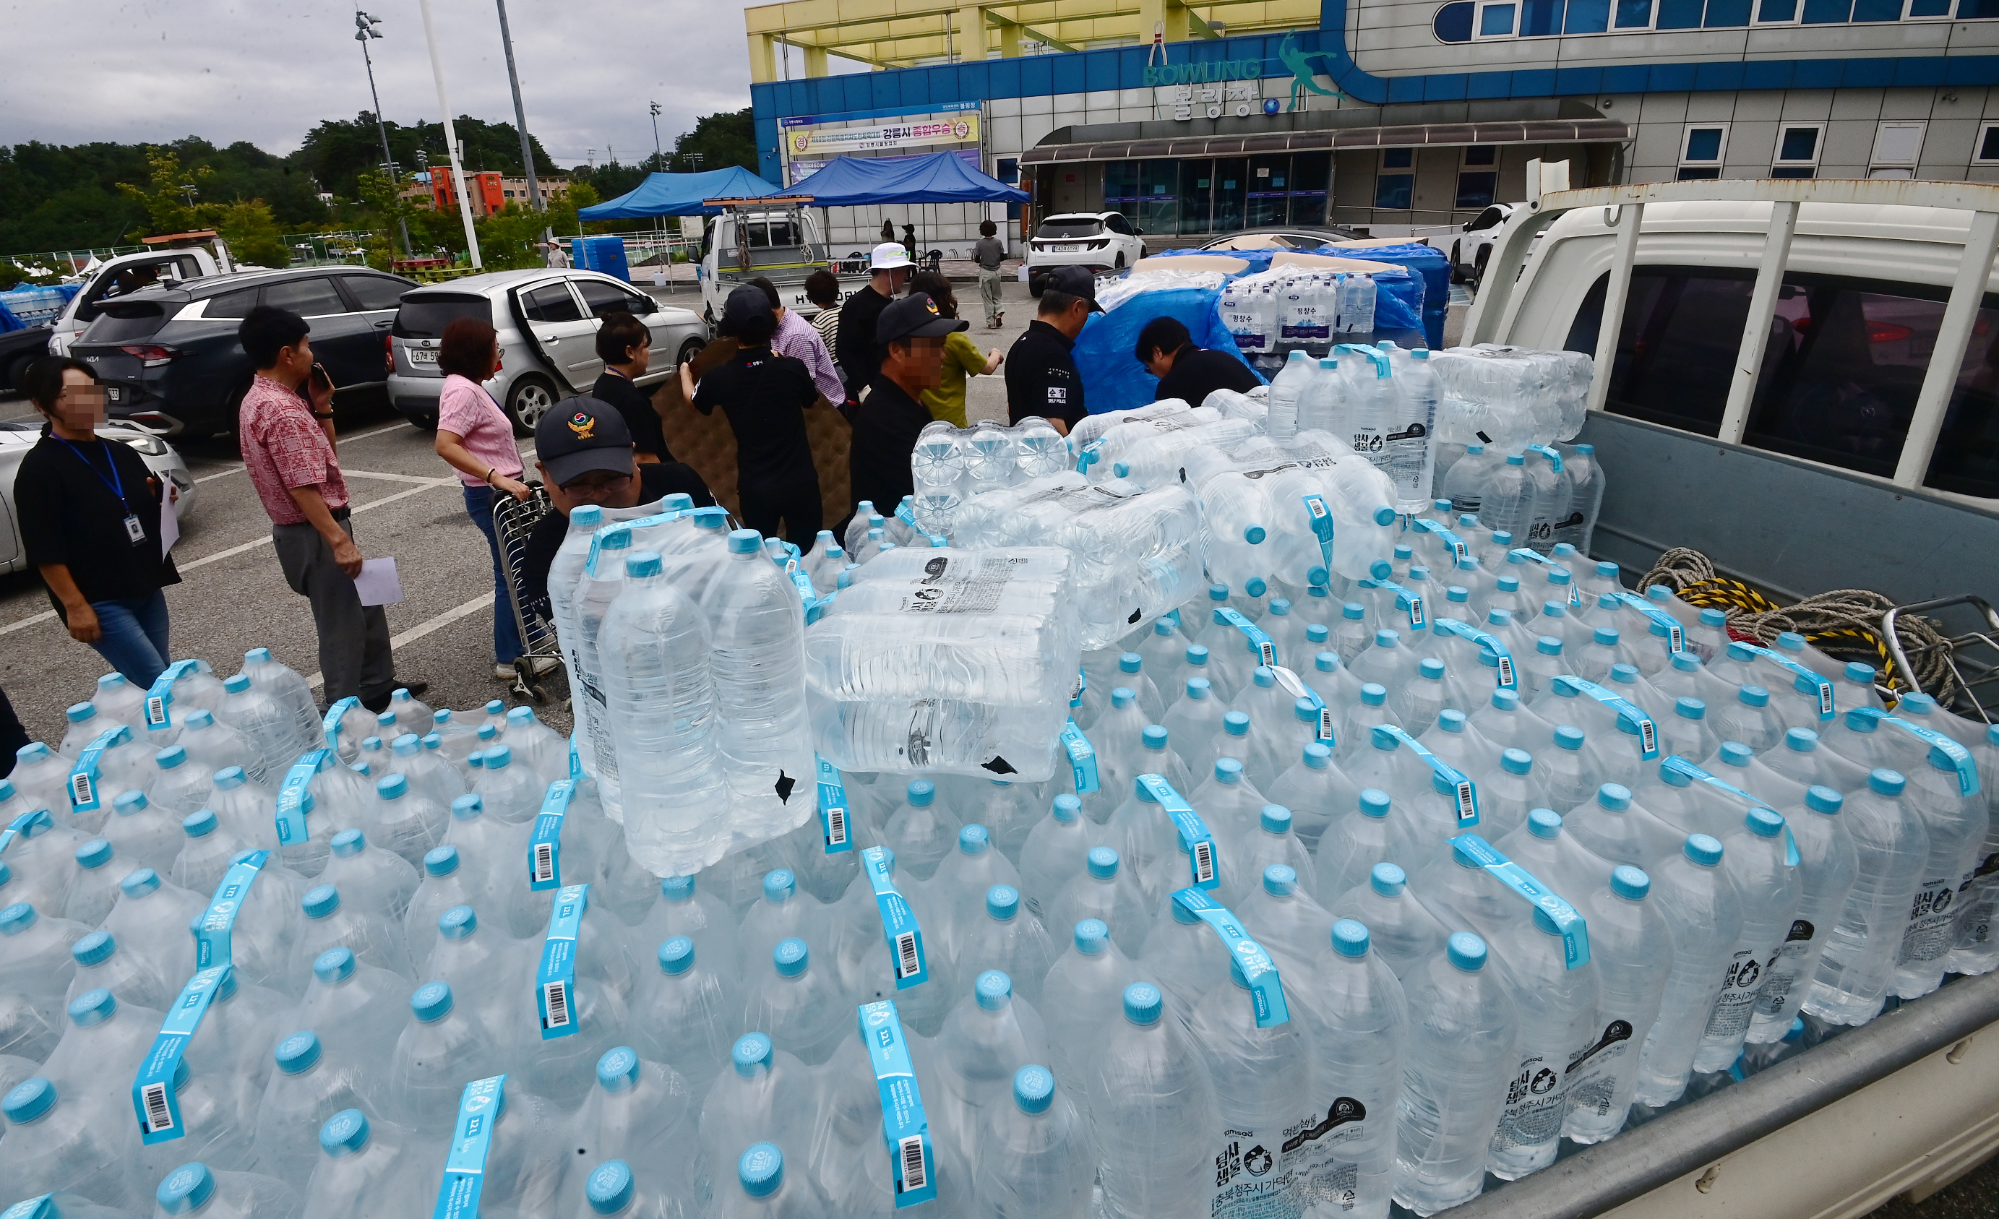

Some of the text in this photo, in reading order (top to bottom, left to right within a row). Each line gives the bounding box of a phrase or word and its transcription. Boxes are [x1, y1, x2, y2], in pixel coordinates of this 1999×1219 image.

[1143, 58, 1260, 86] BOWLING
[1169, 85, 1258, 121] 볼링장
[883, 127, 911, 140] 강릉시
[913, 123, 951, 136] 종합우승
[958, 125, 966, 135] 축
[797, 137, 805, 147] 경
[225, 884, 237, 898] 12L
[562, 905, 570, 917] 12L
[1227, 924, 1239, 938] 12L
[1242, 954, 1262, 977] 탐사
[1252, 951, 1271, 974] 샘물
[185, 991, 198, 1009] 12L
[878, 1029, 891, 1045] 12L
[1510, 1069, 1530, 1093] 탐사
[1506, 1084, 1529, 1106] 샘물
[468, 1117, 479, 1136] 12L
[1215, 1141, 1240, 1169] 탐사
[1215, 1156, 1241, 1187] 샘물
[1234, 1181, 1264, 1197] 청주시
[1265, 1169, 1293, 1191] 가덕면
